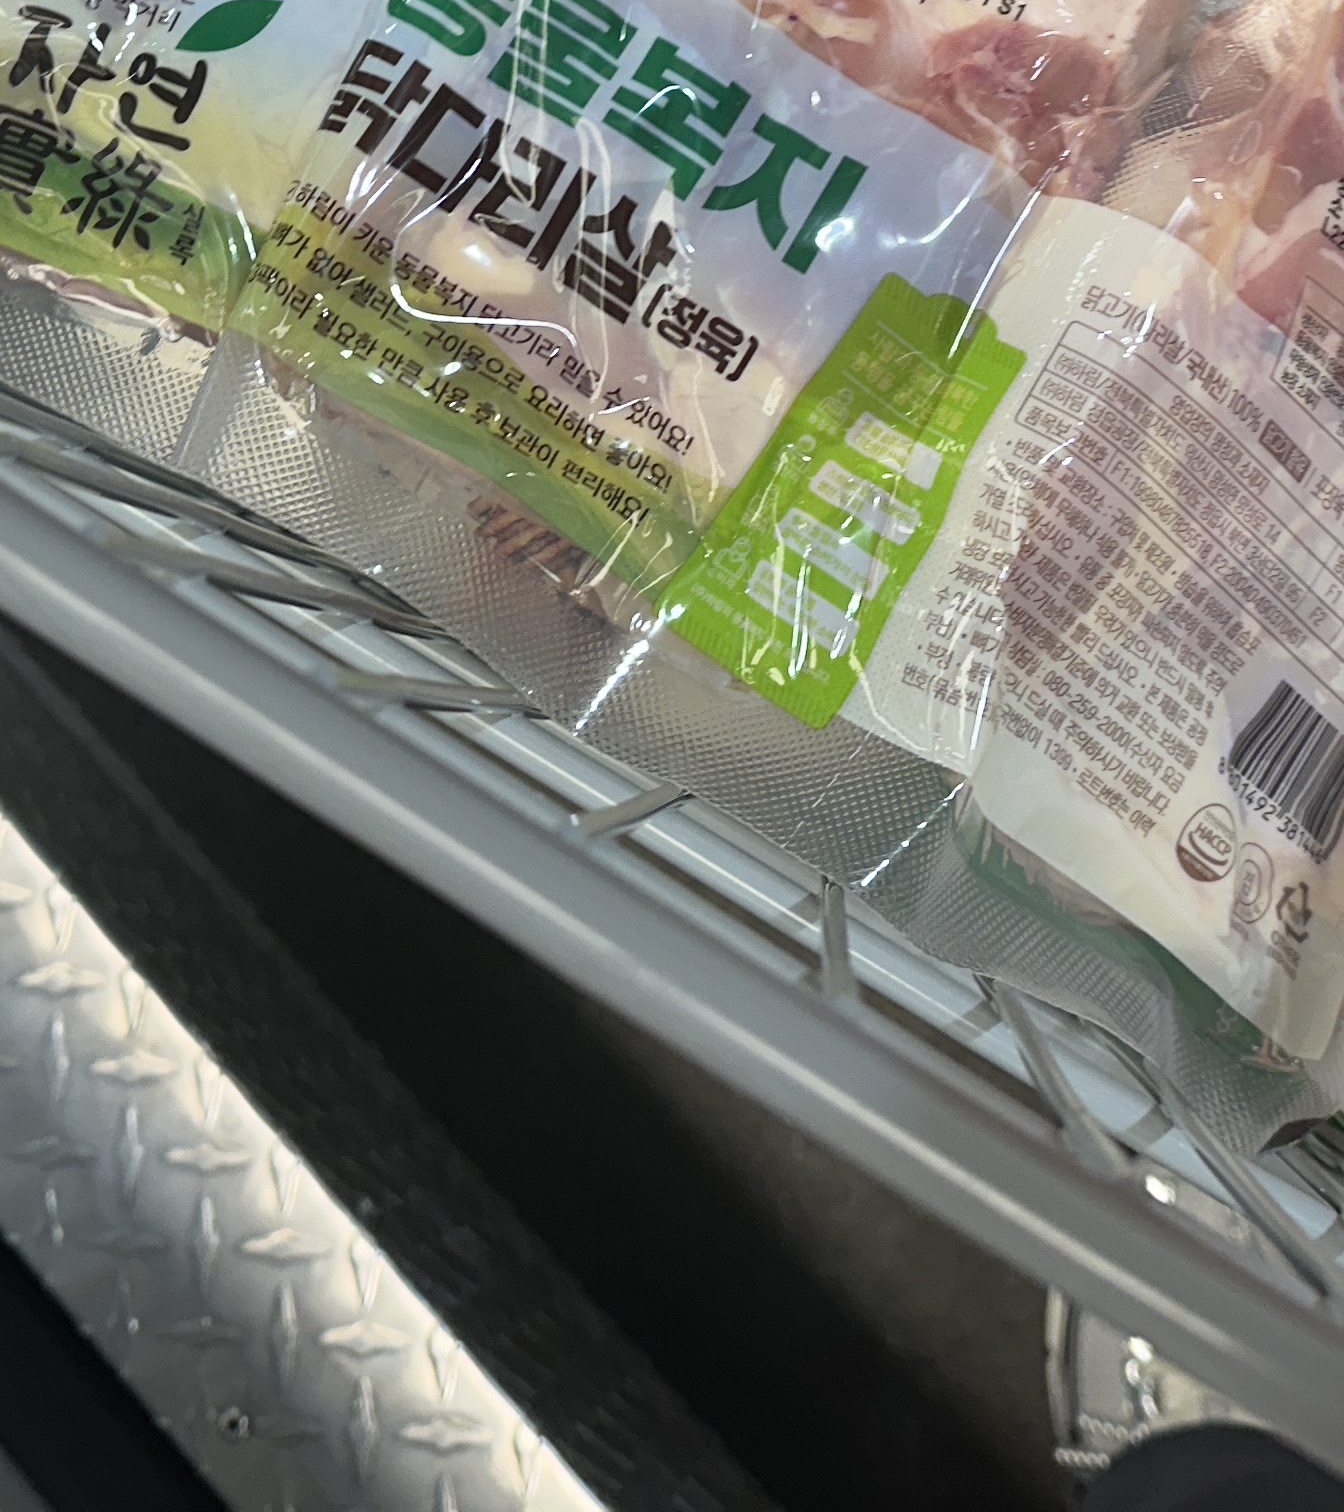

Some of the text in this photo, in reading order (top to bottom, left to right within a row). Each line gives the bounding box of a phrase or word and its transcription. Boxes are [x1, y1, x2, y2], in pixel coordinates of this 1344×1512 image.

[7, 3, 210, 153] 자연
[285, 178, 695, 458] 하림이 키운 동물복지 닭고기라 믿을 수 있어요!
[310, 245, 357, 285] 없어
[353, 274, 414, 337] 샐러드,
[420, 323, 527, 393] 구이용으로
[522, 383, 608, 453] 요리하면
[602, 434, 674, 496] 좋아요!
[315, 309, 651, 528] 필요한 만큼 사용 후 보관이 편리해요!
[1022, 403, 1111, 466] 품목보고번호
[1308, 605, 1328, 627] F2
[1322, 582, 1343, 604] F1
[1093, 641, 1144, 688] 드십시오
[1059, 720, 1128, 779] 주의하시기
[1158, 764, 1187, 794] 요금
[1193, 821, 1234, 858] HACCP
